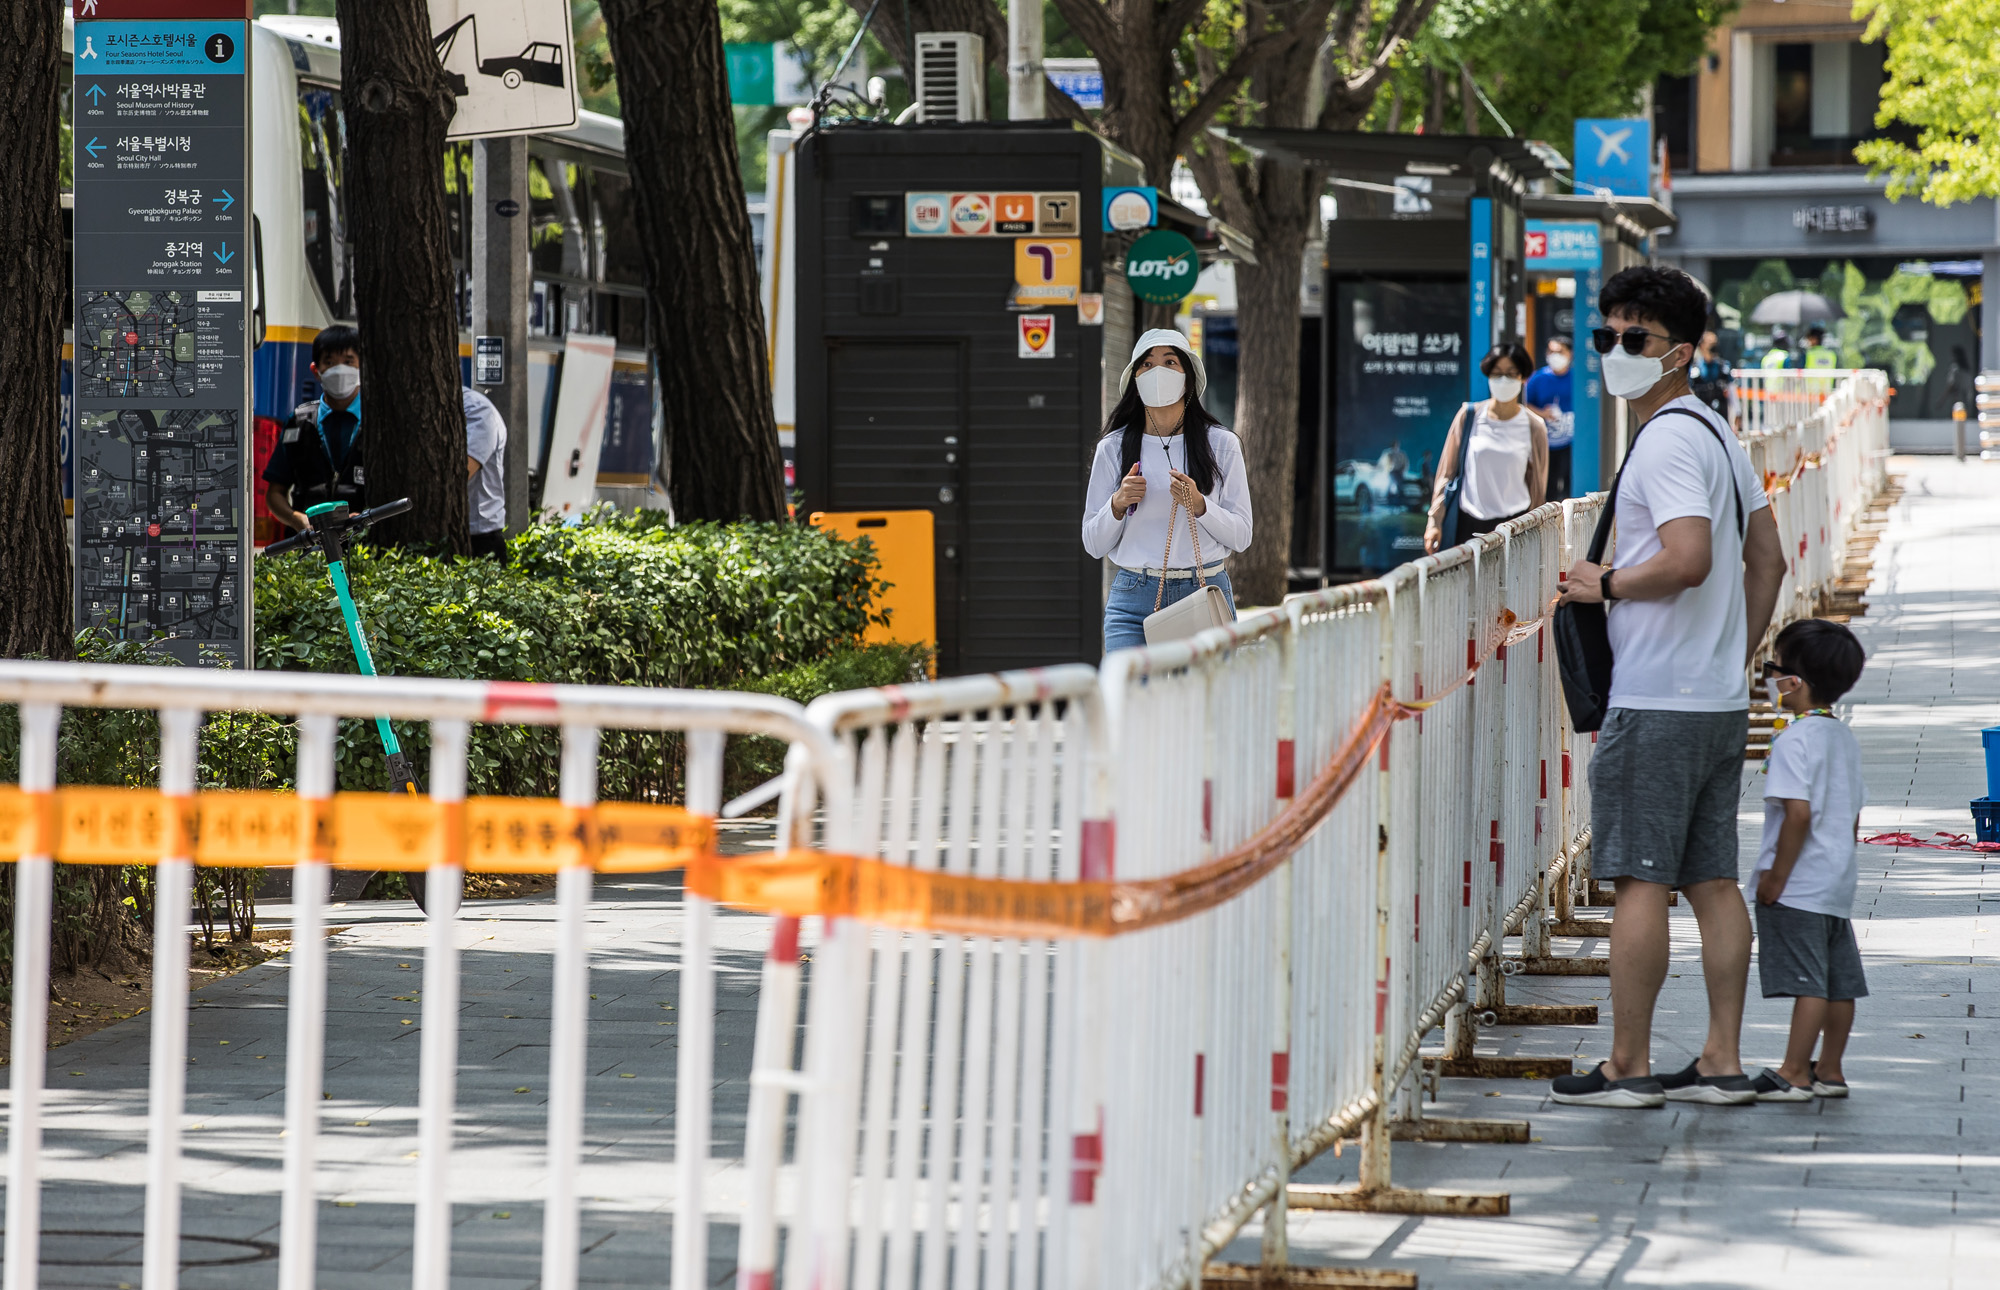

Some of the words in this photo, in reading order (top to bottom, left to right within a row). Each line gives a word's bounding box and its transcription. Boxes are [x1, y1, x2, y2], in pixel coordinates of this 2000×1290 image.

[105, 33, 198, 48] 포시즌스호텔서울
[105, 50, 120, 58] Four
[120, 50, 147, 58] Seasons
[147, 50, 165, 58] Hotel
[165, 50, 184, 58] Seoul
[116, 83, 206, 99] 서울역사박물관
[116, 101, 134, 109] Seoul
[135, 101, 163, 109] Museum
[163, 101, 171, 109] of
[171, 101, 195, 111] History
[116, 136, 191, 152] 서울특별시청
[116, 154, 135, 162] Seoul
[135, 154, 148, 163] City
[148, 154, 162, 162] Hall
[164, 188, 203, 205] 경복궁
[128, 207, 182, 216] Gyeongbokgung
[182, 207, 203, 215] Palace
[214, 214, 233, 222] 610m
[164, 241, 203, 258] 종각역
[152, 260, 179, 269] Jonggak
[179, 260, 203, 268] Station
[1127, 259, 1190, 280] LOTTO
[215, 267, 233, 275] 540m
